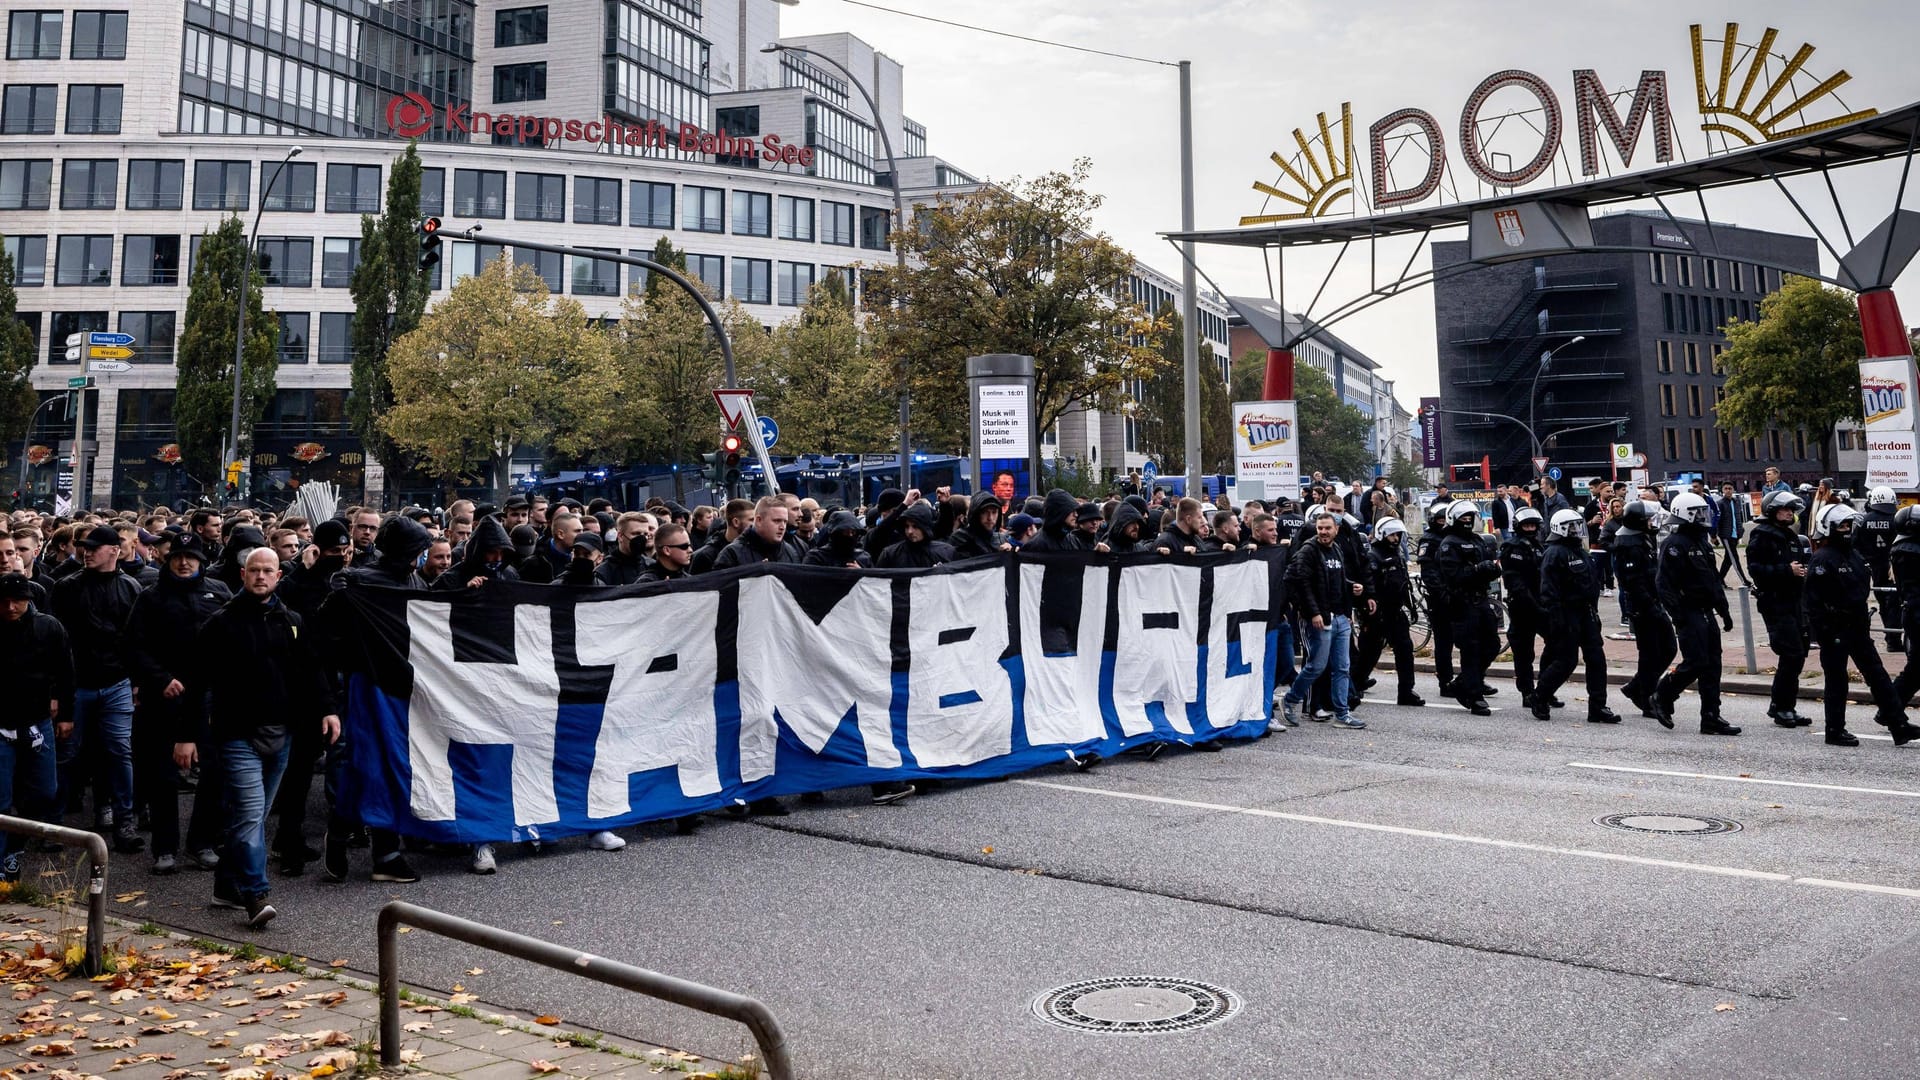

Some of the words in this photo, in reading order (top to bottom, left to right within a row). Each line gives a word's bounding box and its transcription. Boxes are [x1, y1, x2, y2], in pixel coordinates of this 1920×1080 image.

[446, 102, 667, 150] Knappschaft
[680, 123, 755, 159] Bahn
[762, 133, 815, 167] See
[1370, 69, 1673, 209] DOM
[1863, 387, 1905, 417] DOM
[1427, 418, 1436, 448] Premier
[255, 453, 278, 466] JEVER
[340, 452, 362, 464] JEVER
[1866, 521, 1890, 529] POLIZEI
[406, 560, 1269, 826] HAMBURG
